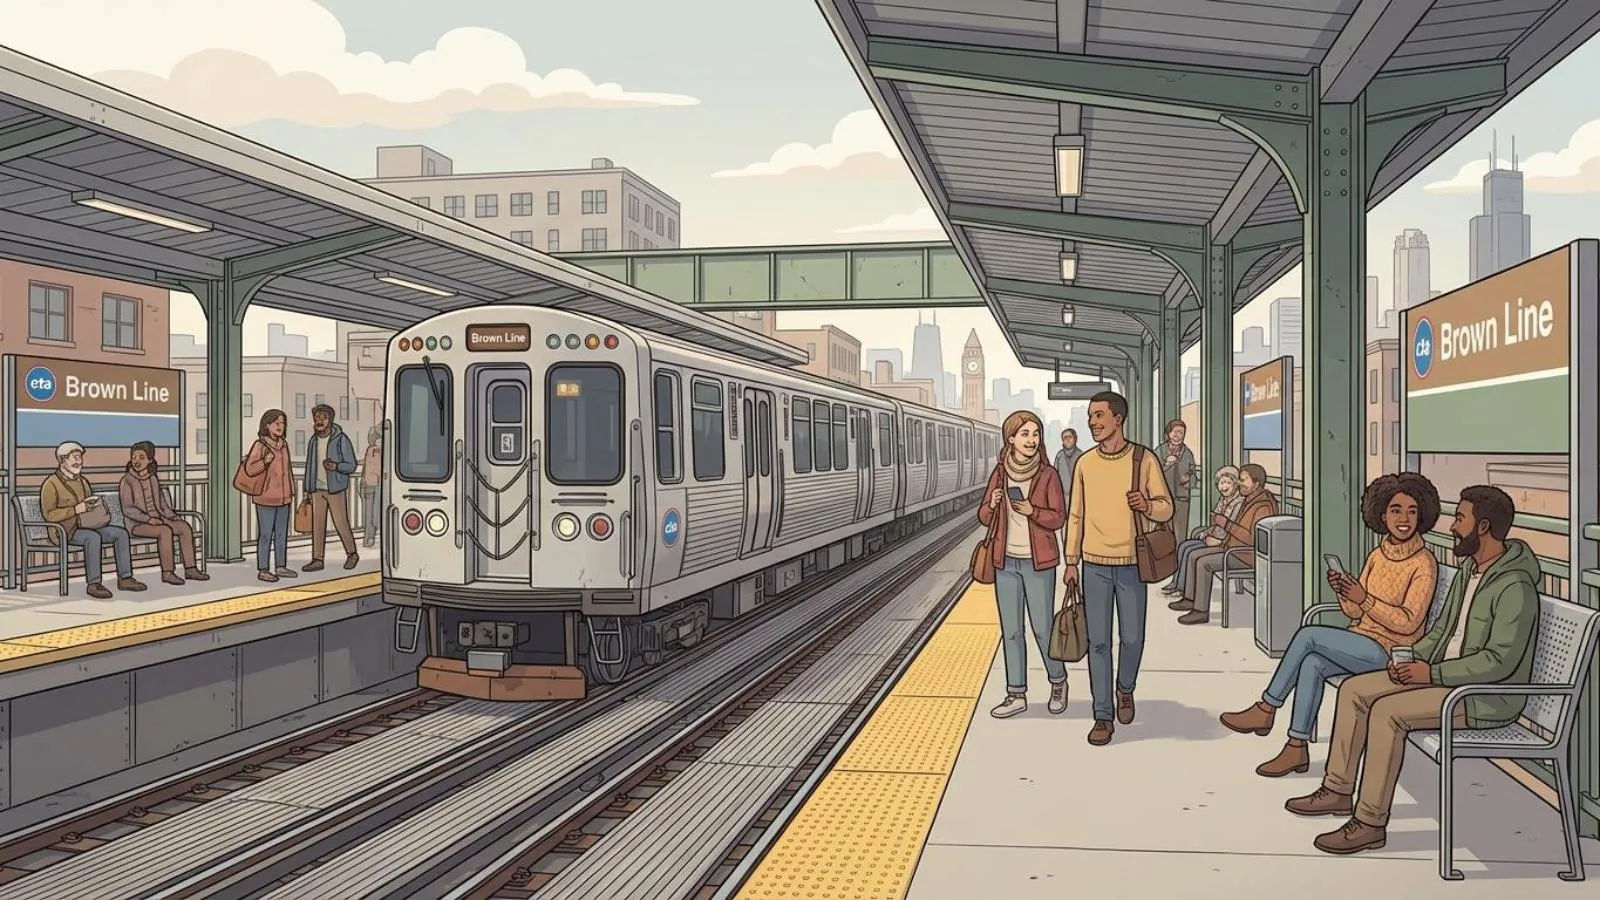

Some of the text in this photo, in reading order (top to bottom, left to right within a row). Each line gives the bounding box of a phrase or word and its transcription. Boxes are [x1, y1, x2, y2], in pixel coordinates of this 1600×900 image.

[471, 332, 526, 343] Brown Line
[1441, 297, 1553, 361] Brown Line
[66, 375, 169, 402] Brown Line
